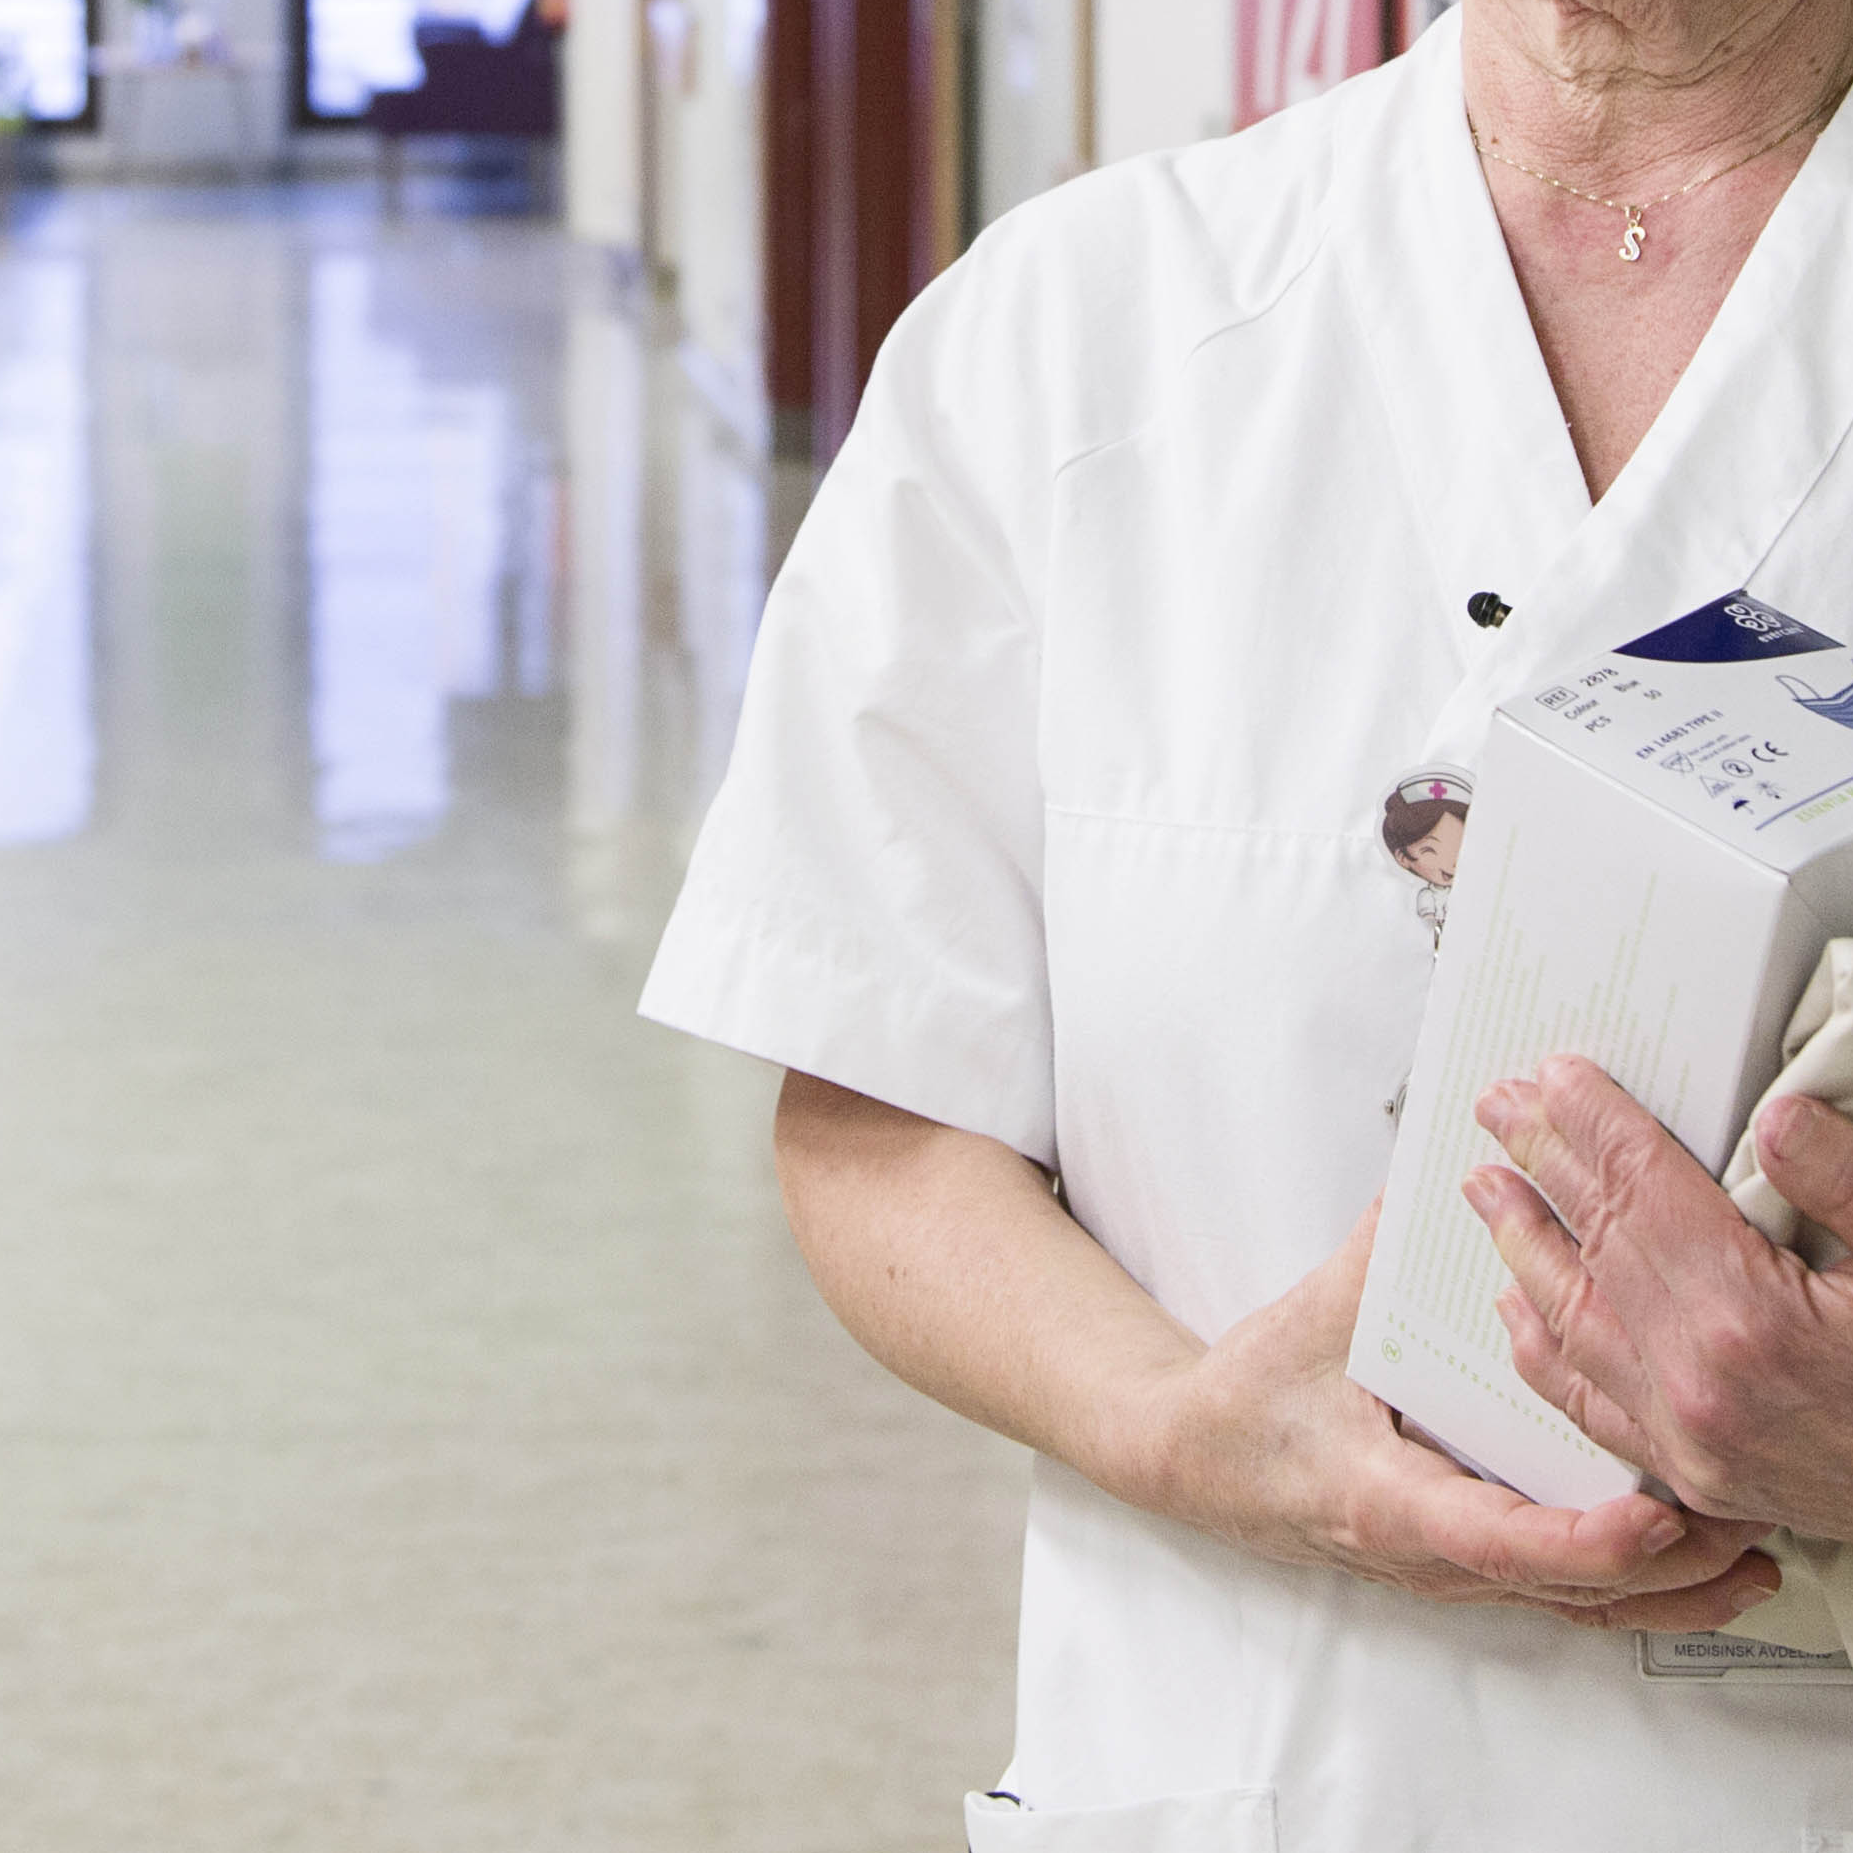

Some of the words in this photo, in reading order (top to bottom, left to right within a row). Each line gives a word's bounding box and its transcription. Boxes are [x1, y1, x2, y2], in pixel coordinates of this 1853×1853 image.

[1544, 689, 1569, 707] REF
[1580, 667, 1619, 688] 2878
[1584, 715, 1611, 734] PCS
[1675, 1643, 1755, 1658] MEDISINSK
